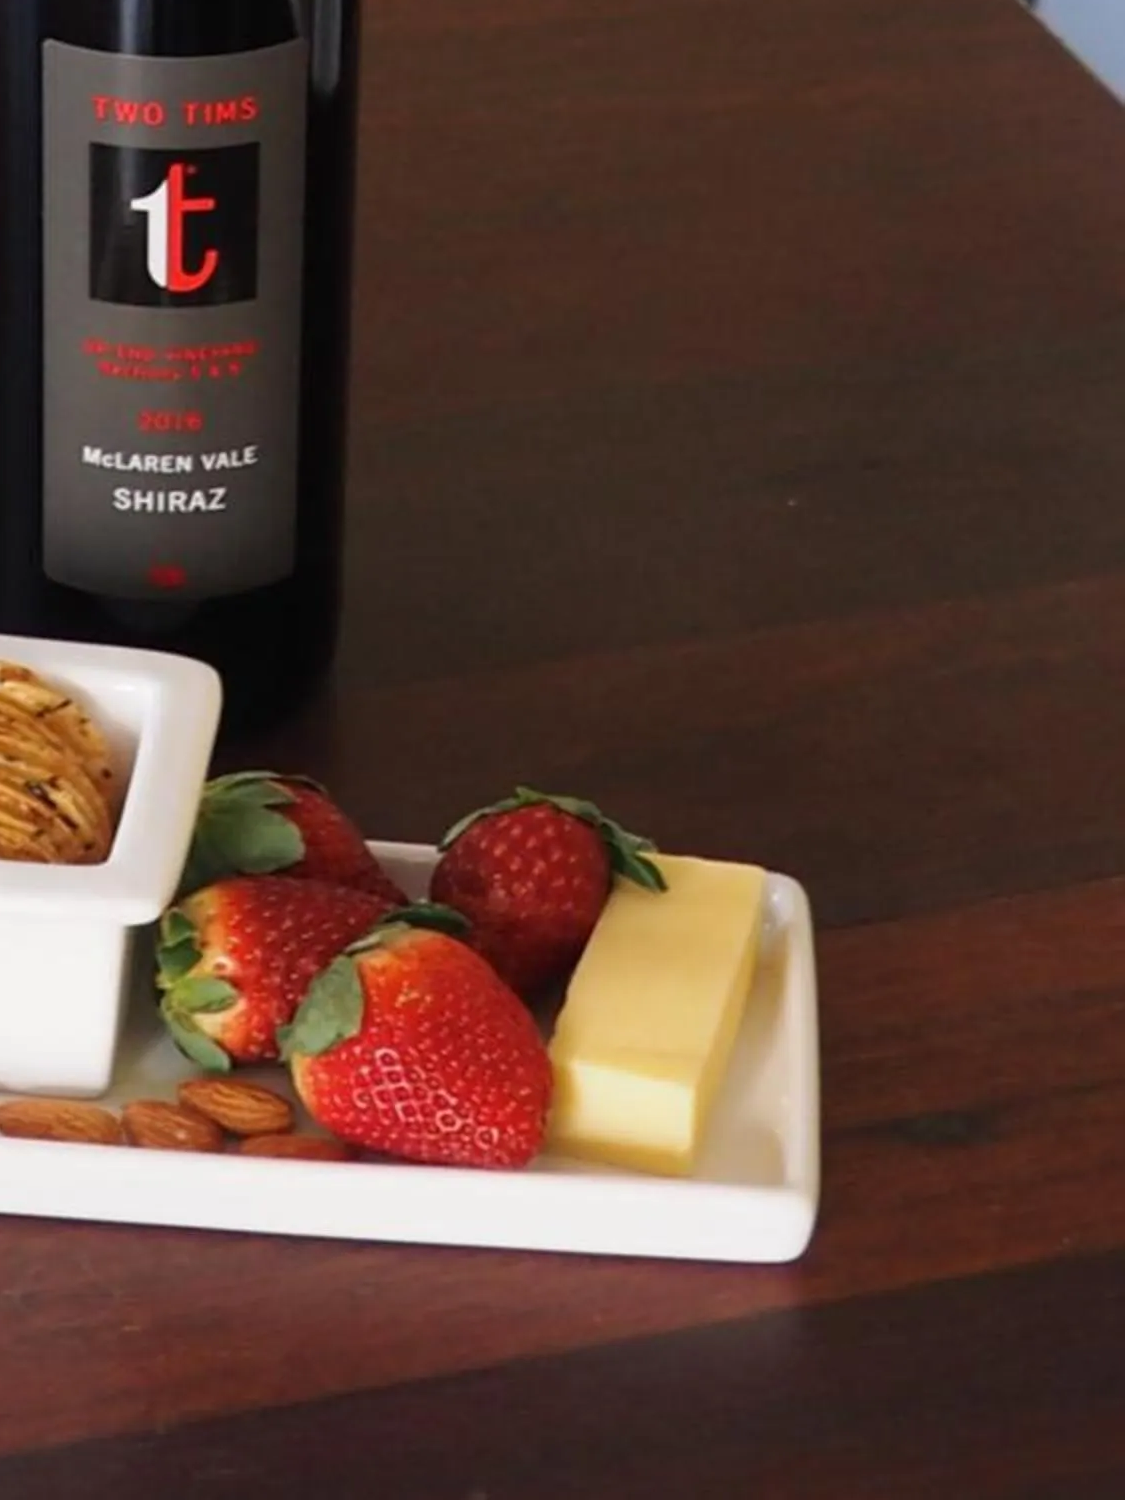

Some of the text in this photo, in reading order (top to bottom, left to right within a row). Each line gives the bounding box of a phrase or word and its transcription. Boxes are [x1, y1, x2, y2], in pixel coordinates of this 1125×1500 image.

[91, 97, 259, 125] TWO TIMS
[82, 445, 259, 473] McLAREN VALE
[113, 487, 227, 513] SHIRAZ
